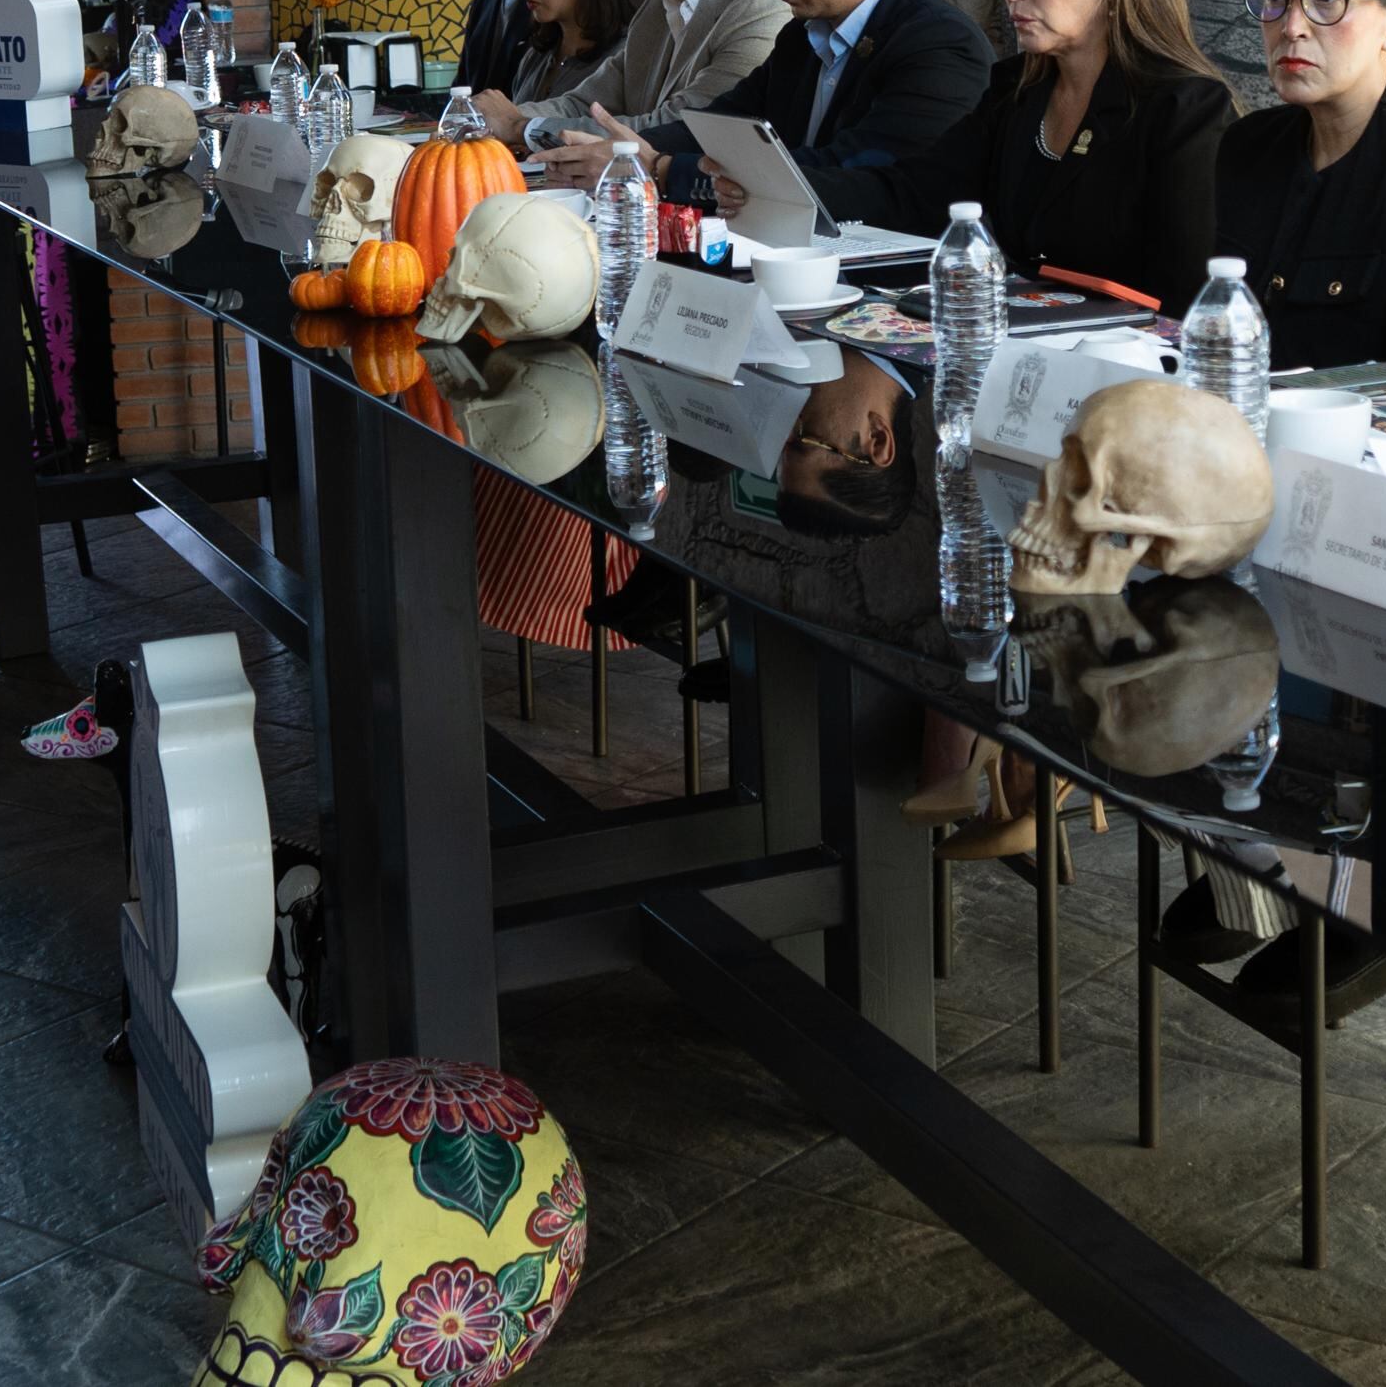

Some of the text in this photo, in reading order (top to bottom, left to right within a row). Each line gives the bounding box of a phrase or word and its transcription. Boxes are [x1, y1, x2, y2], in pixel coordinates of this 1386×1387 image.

[699, 310, 729, 330] PRECIADO
[1324, 538, 1371, 565] SECRETARIO
[1371, 554, 1383, 568] DE
